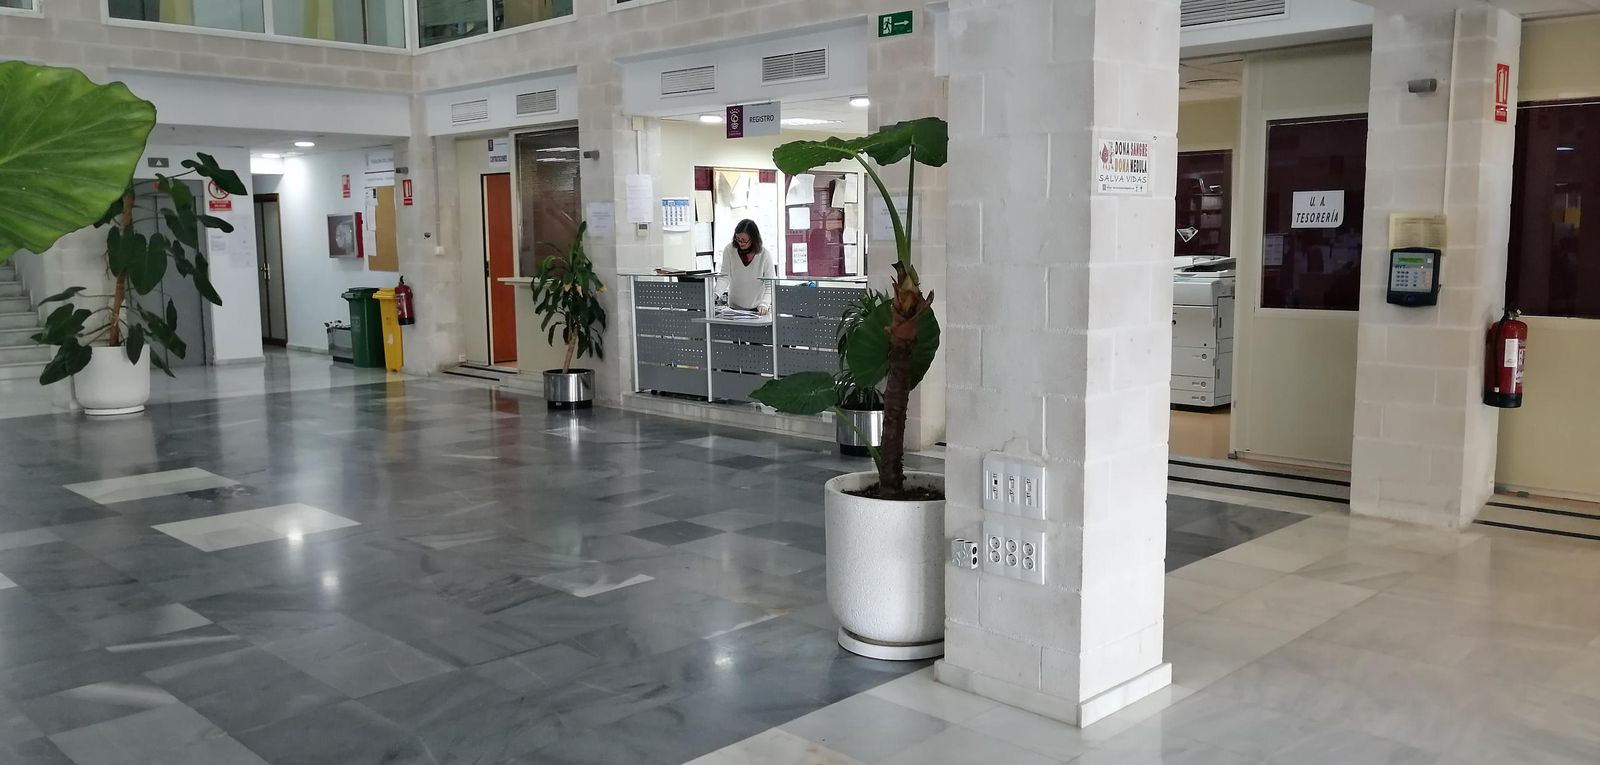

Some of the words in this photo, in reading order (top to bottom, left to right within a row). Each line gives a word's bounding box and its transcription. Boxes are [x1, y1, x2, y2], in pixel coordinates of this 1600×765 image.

[749, 114, 775, 123] REGISTRO
[1115, 141, 1130, 156] DONA
[1130, 142, 1148, 157] SANGRE
[1115, 158, 1130, 173] DONA
[1130, 159, 1148, 173] MEDULA
[1099, 174, 1125, 183] SALVA
[1126, 175, 1147, 184] VIDAS
[1296, 208, 1339, 223] TESORERÍA
